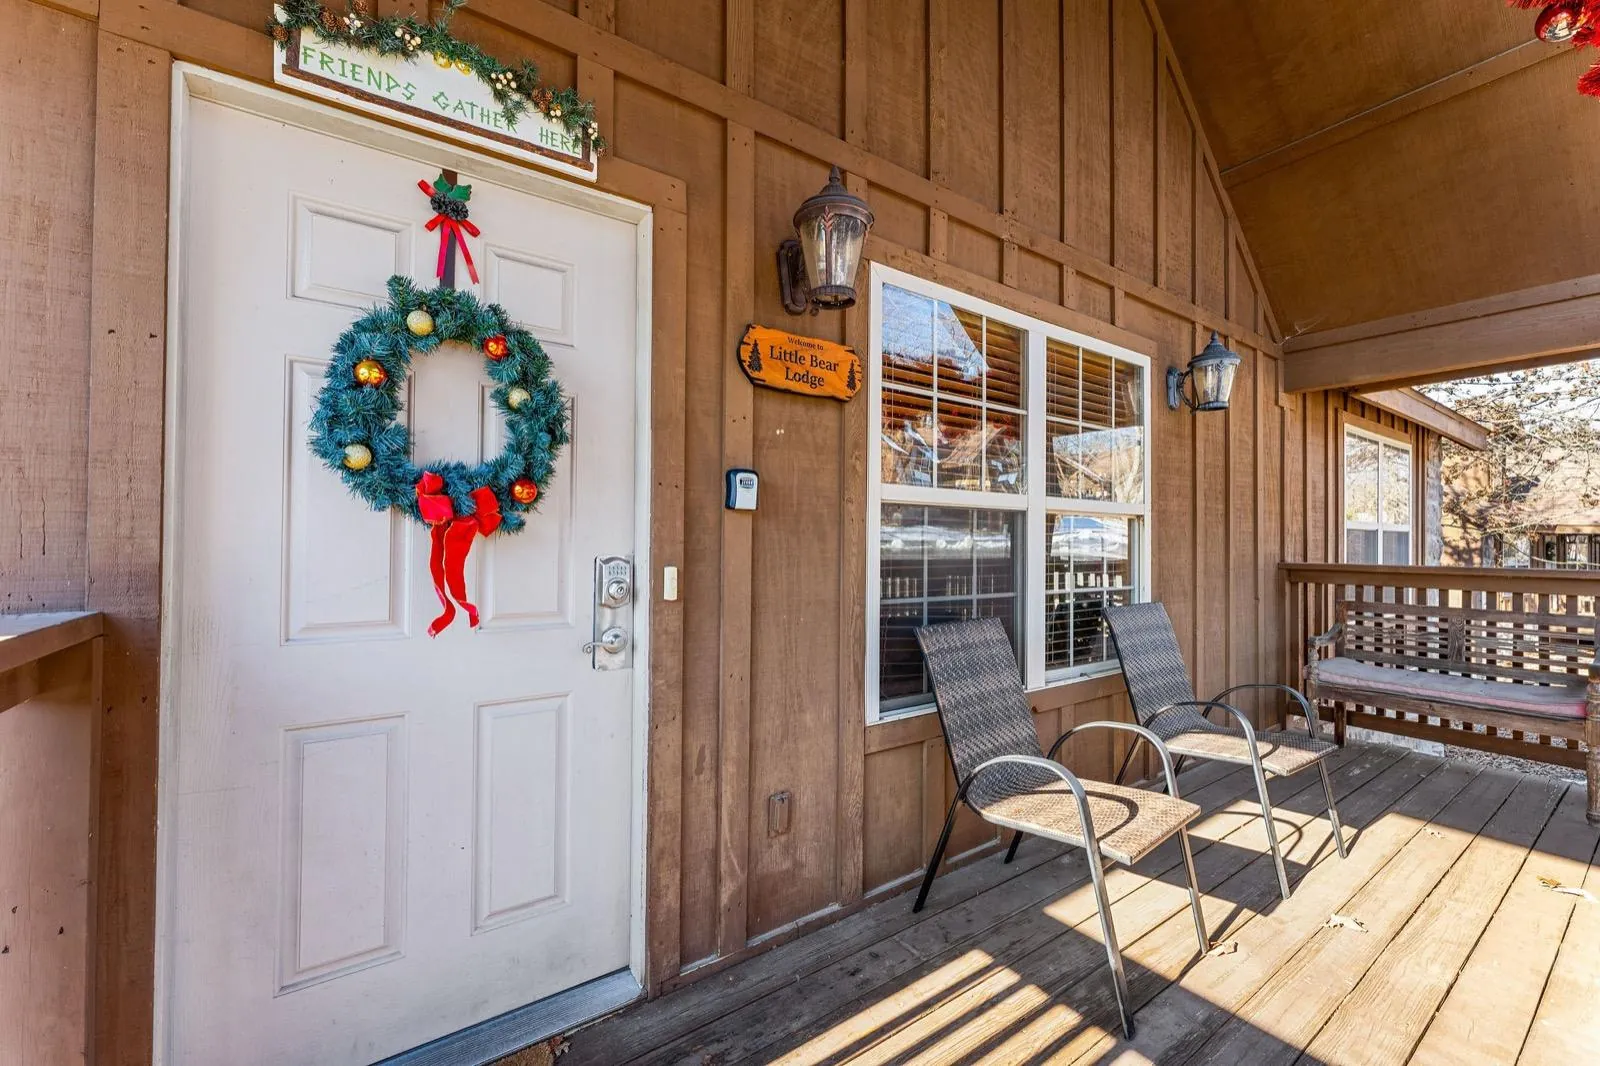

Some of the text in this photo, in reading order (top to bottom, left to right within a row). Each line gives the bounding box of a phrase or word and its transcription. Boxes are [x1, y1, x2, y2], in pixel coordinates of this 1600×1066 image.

[301, 45, 417, 101] FRIENDS
[787, 336, 824, 351] Welcome to
[769, 345, 839, 372] Little Bear
[785, 366, 825, 389] Lodge
